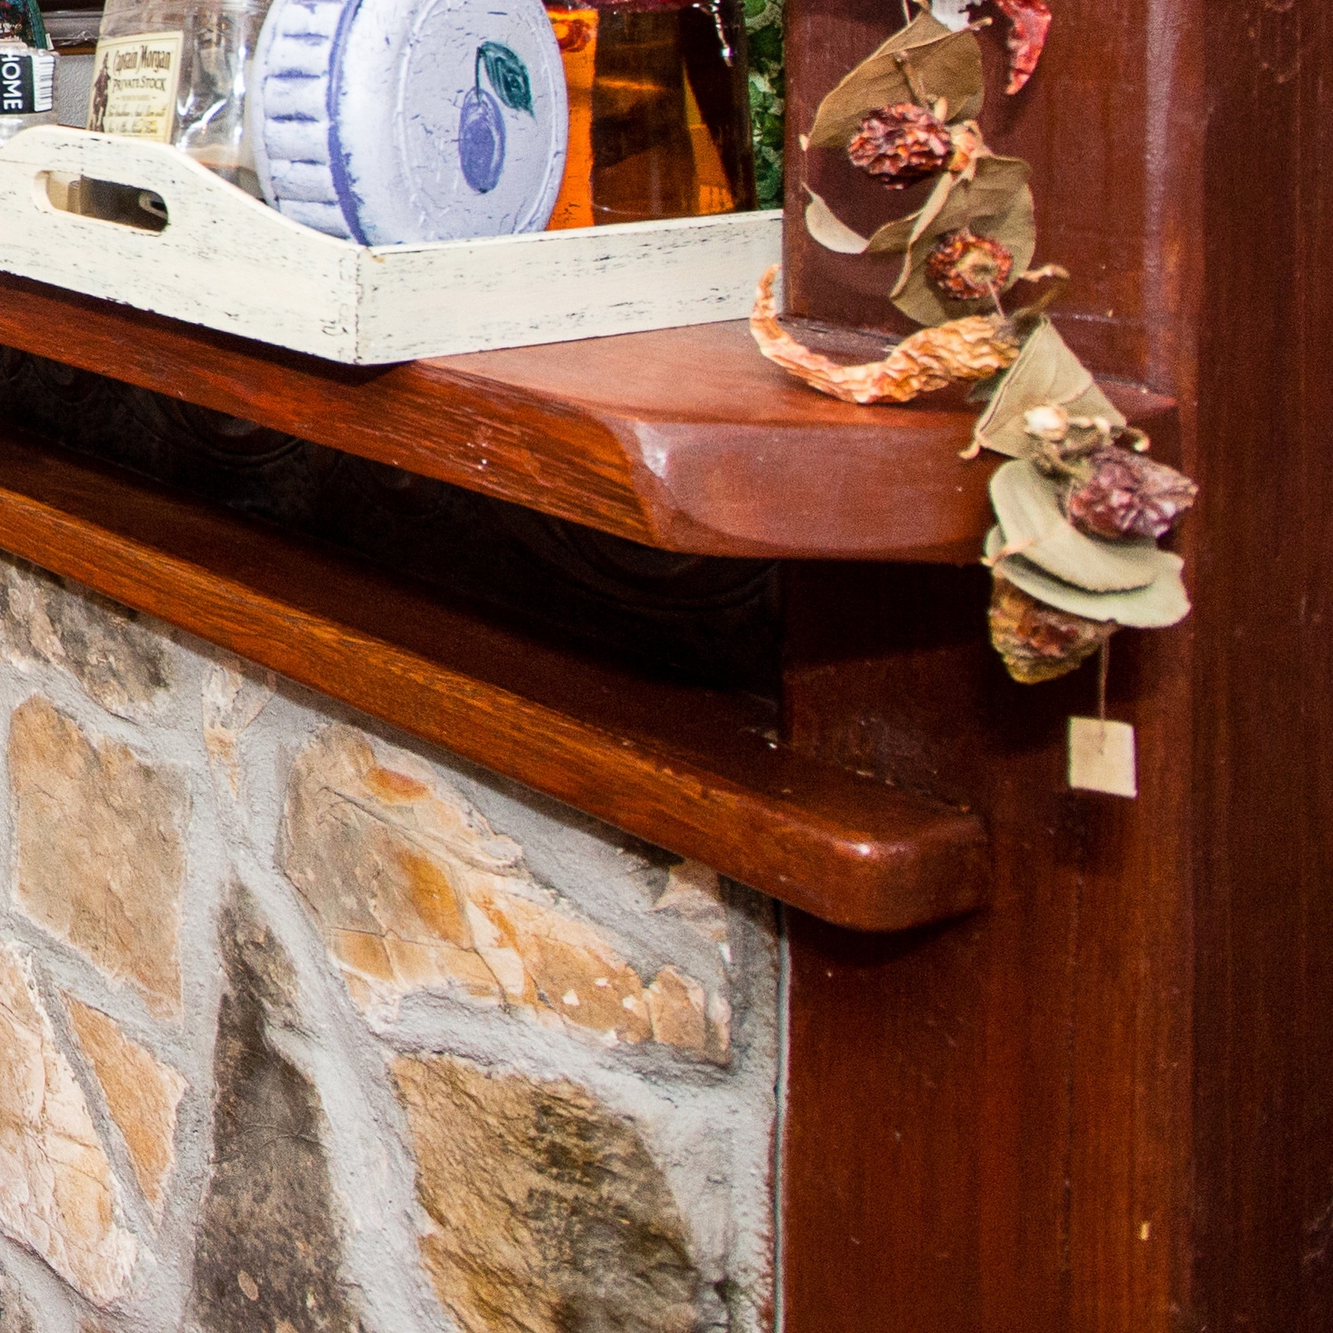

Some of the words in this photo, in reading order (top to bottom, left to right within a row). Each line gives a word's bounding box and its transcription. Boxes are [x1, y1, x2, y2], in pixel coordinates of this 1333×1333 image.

[113, 50, 138, 75] Captain
[137, 45, 170, 73] Morgan
[140, 76, 166, 91] STOCK
